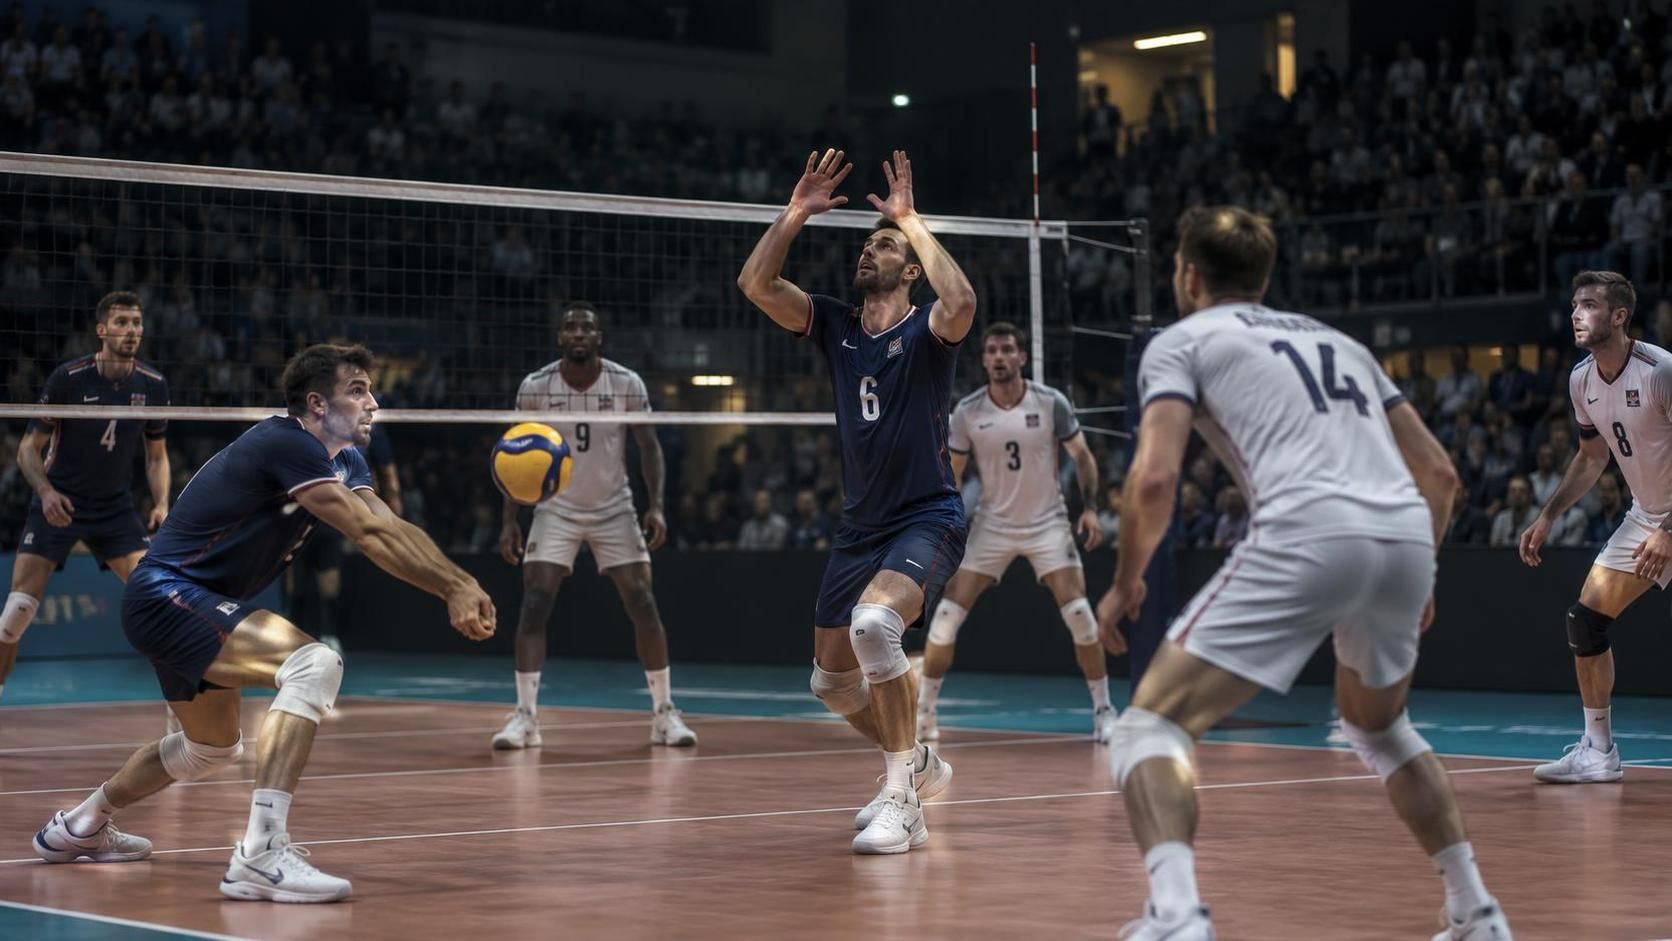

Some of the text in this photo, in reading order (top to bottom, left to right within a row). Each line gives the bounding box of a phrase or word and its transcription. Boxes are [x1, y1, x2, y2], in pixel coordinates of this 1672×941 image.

[1269, 339, 1370, 418] 14
[859, 376, 880, 421] 6
[100, 419, 117, 452] 4
[575, 422, 590, 453] 9
[1612, 421, 1633, 457] 8
[1005, 441, 1021, 471] 3
